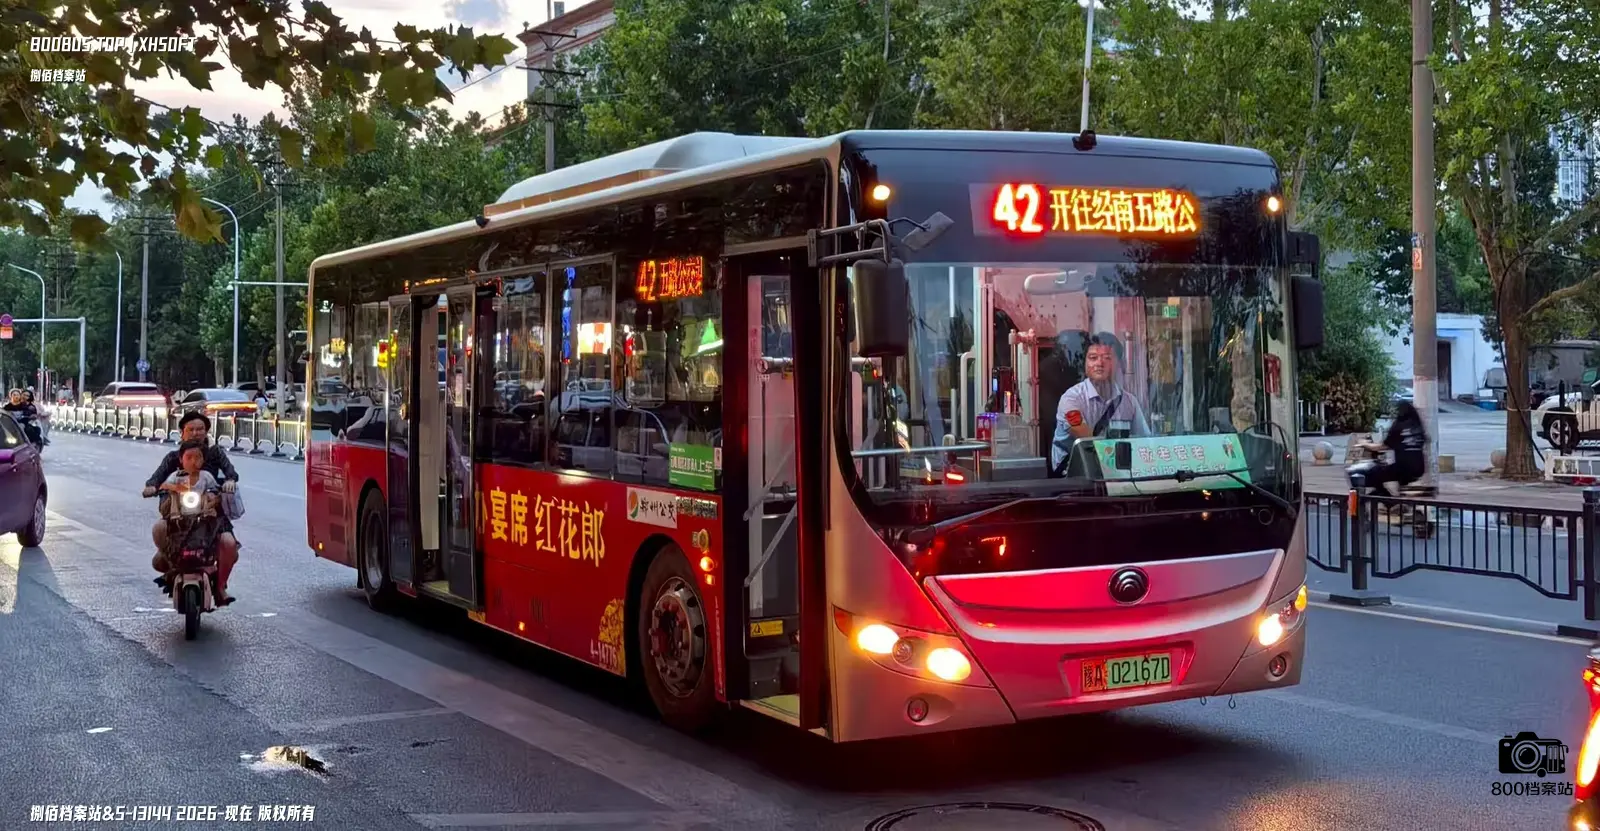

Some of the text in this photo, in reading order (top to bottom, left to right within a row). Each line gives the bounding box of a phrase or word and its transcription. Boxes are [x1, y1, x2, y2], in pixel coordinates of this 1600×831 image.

[994, 183, 1197, 233] 42 开往经南五路公
[636, 260, 656, 300] 42
[534, 493, 606, 568] 红花郎
[640, 497, 676, 522] 郑州公交
